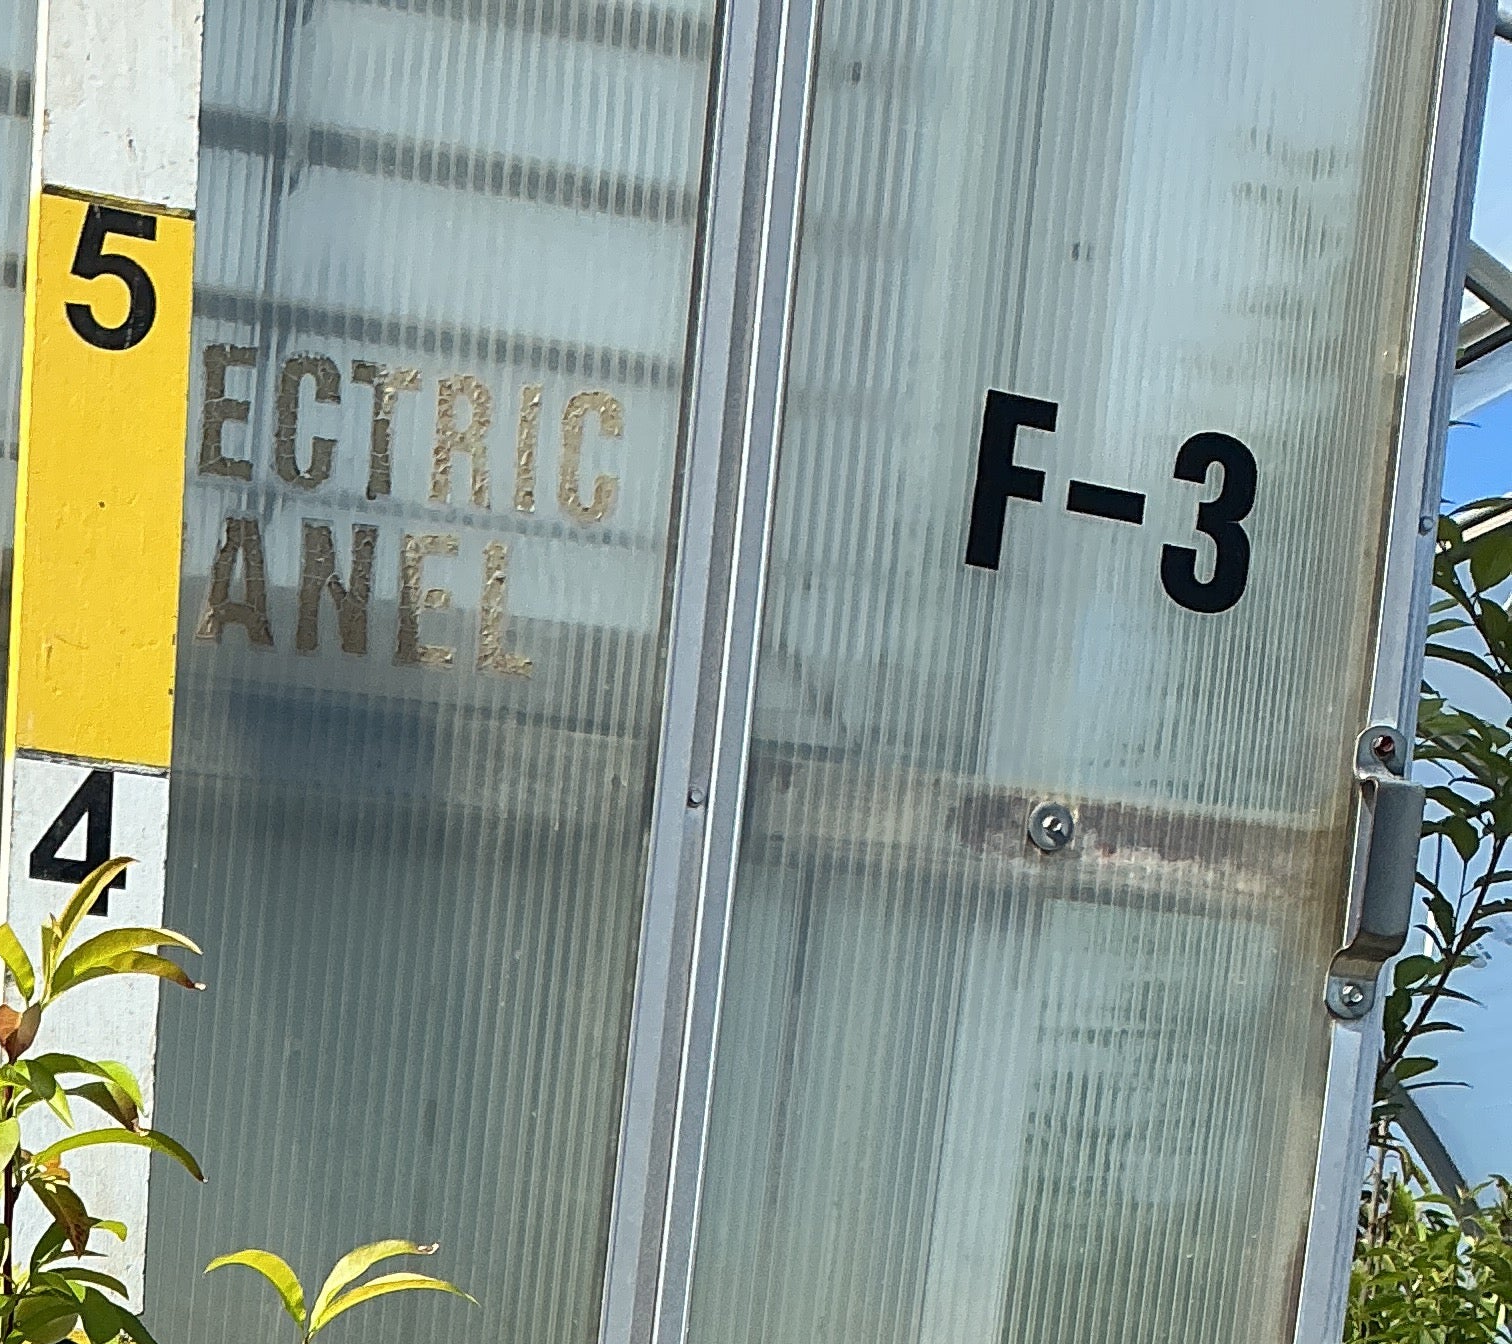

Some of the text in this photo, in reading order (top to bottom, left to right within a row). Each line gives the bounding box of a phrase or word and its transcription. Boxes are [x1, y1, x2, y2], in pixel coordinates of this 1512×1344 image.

[64, 204, 158, 352] 5
[965, 388, 1258, 614] F-3
[29, 768, 126, 917] 4
